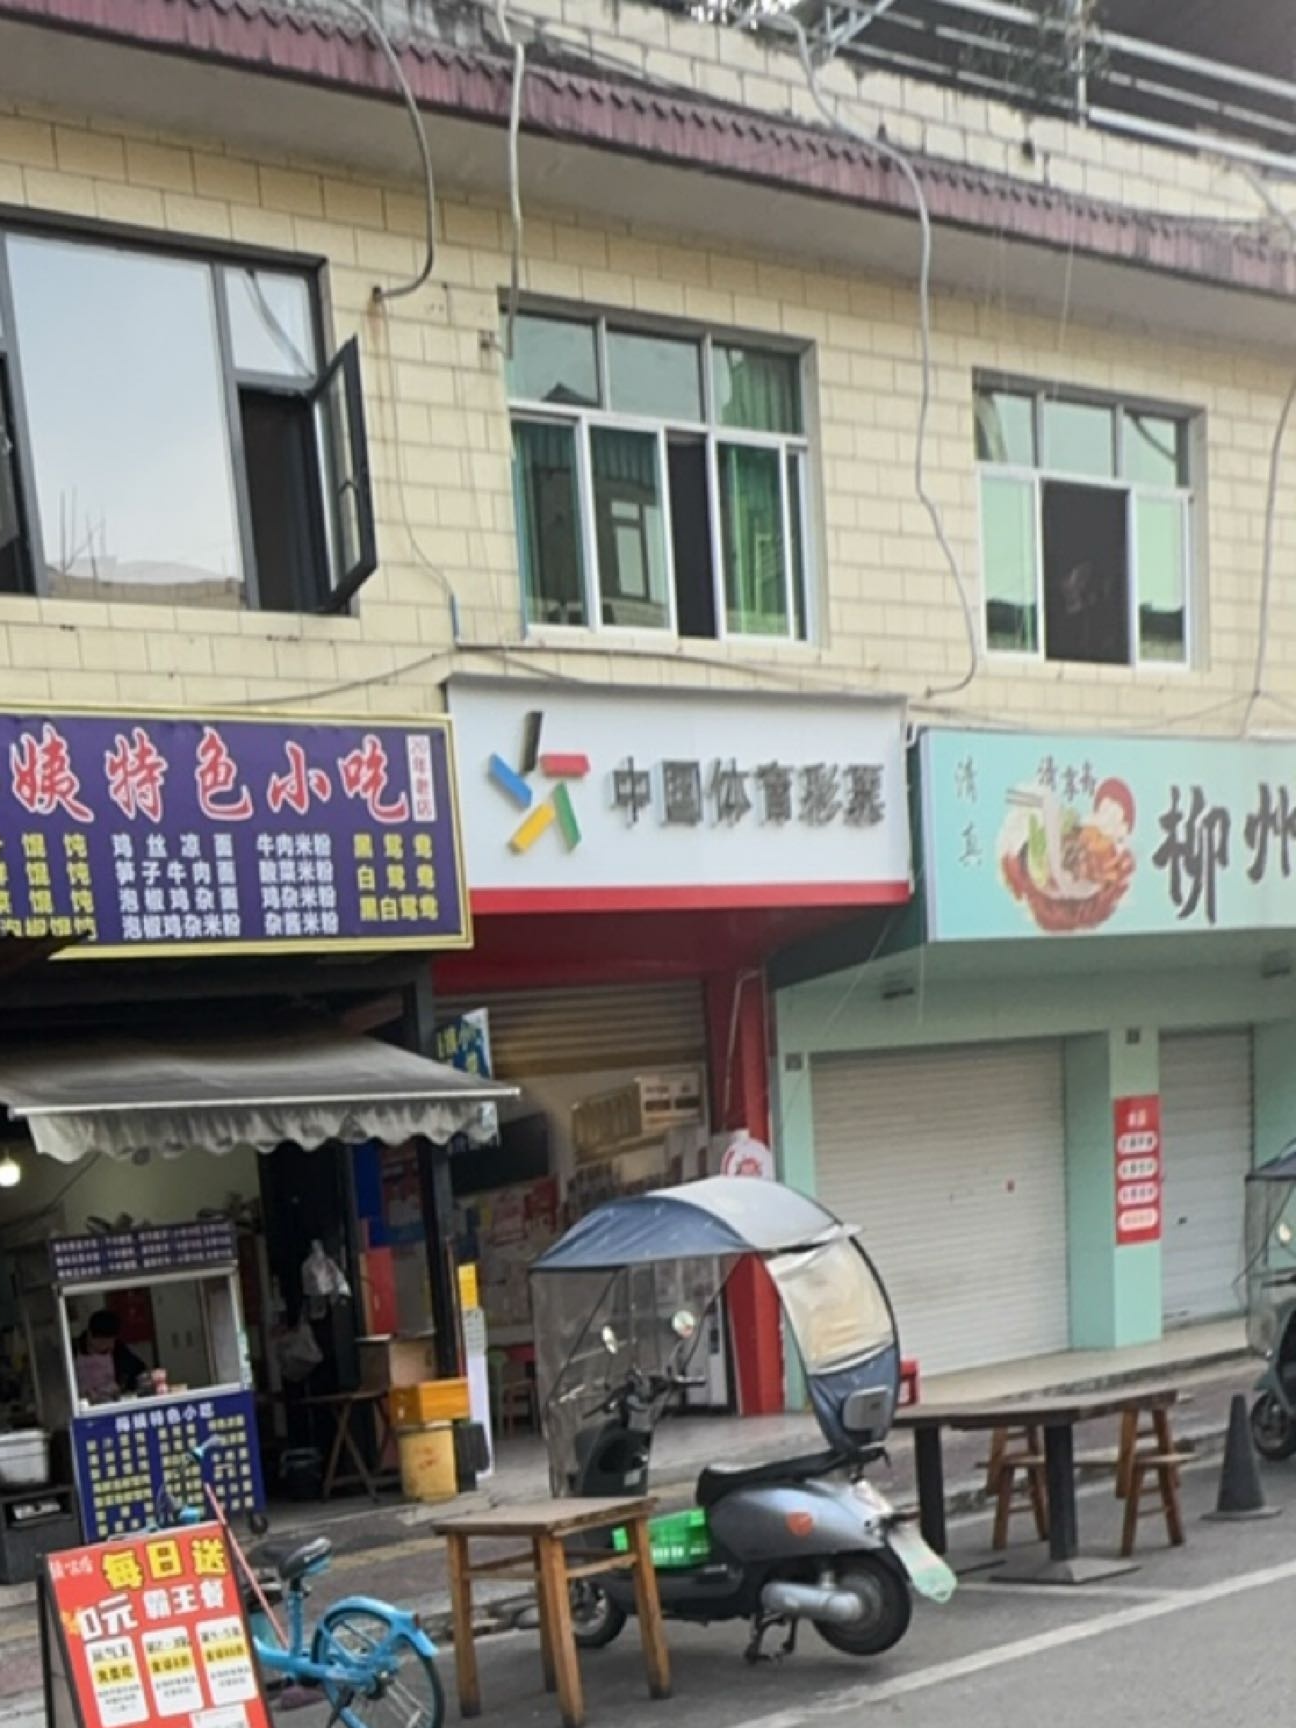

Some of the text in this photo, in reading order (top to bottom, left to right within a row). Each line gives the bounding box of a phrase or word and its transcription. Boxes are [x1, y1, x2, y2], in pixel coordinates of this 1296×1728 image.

[611, 757, 885, 828] 中国体育彩票
[257, 833, 331, 857] 牛肉米粉
[102, 1538, 229, 1590] 每日送
